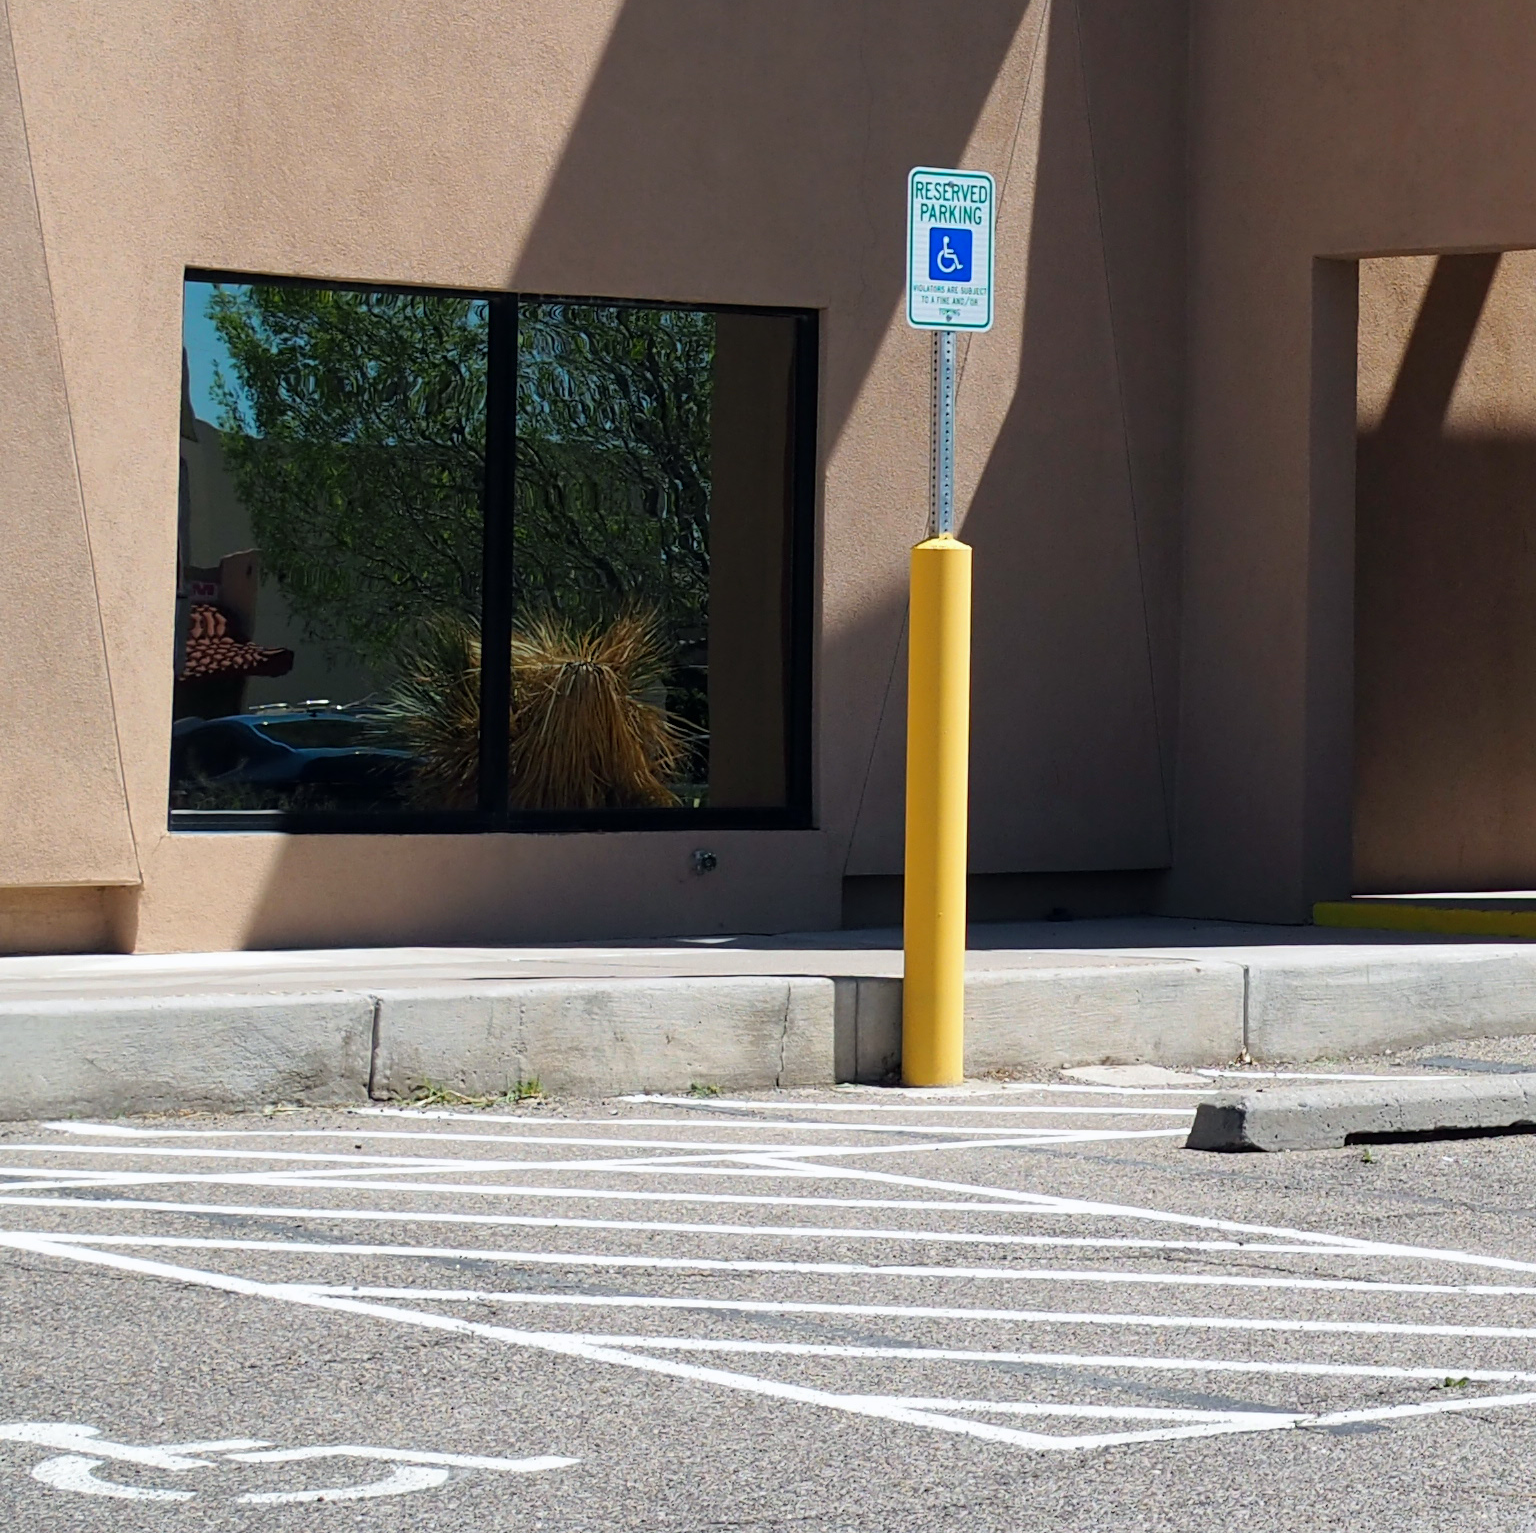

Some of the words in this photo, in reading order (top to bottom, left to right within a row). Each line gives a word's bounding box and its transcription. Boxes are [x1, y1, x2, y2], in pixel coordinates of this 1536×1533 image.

[915, 181, 988, 204] RESERVED
[920, 203, 982, 225] PARKING
[913, 284, 944, 293] VIOLATORS
[946, 285, 958, 294] ARE
[960, 286, 986, 295] SUBJECT
[921, 294, 929, 303] TO
